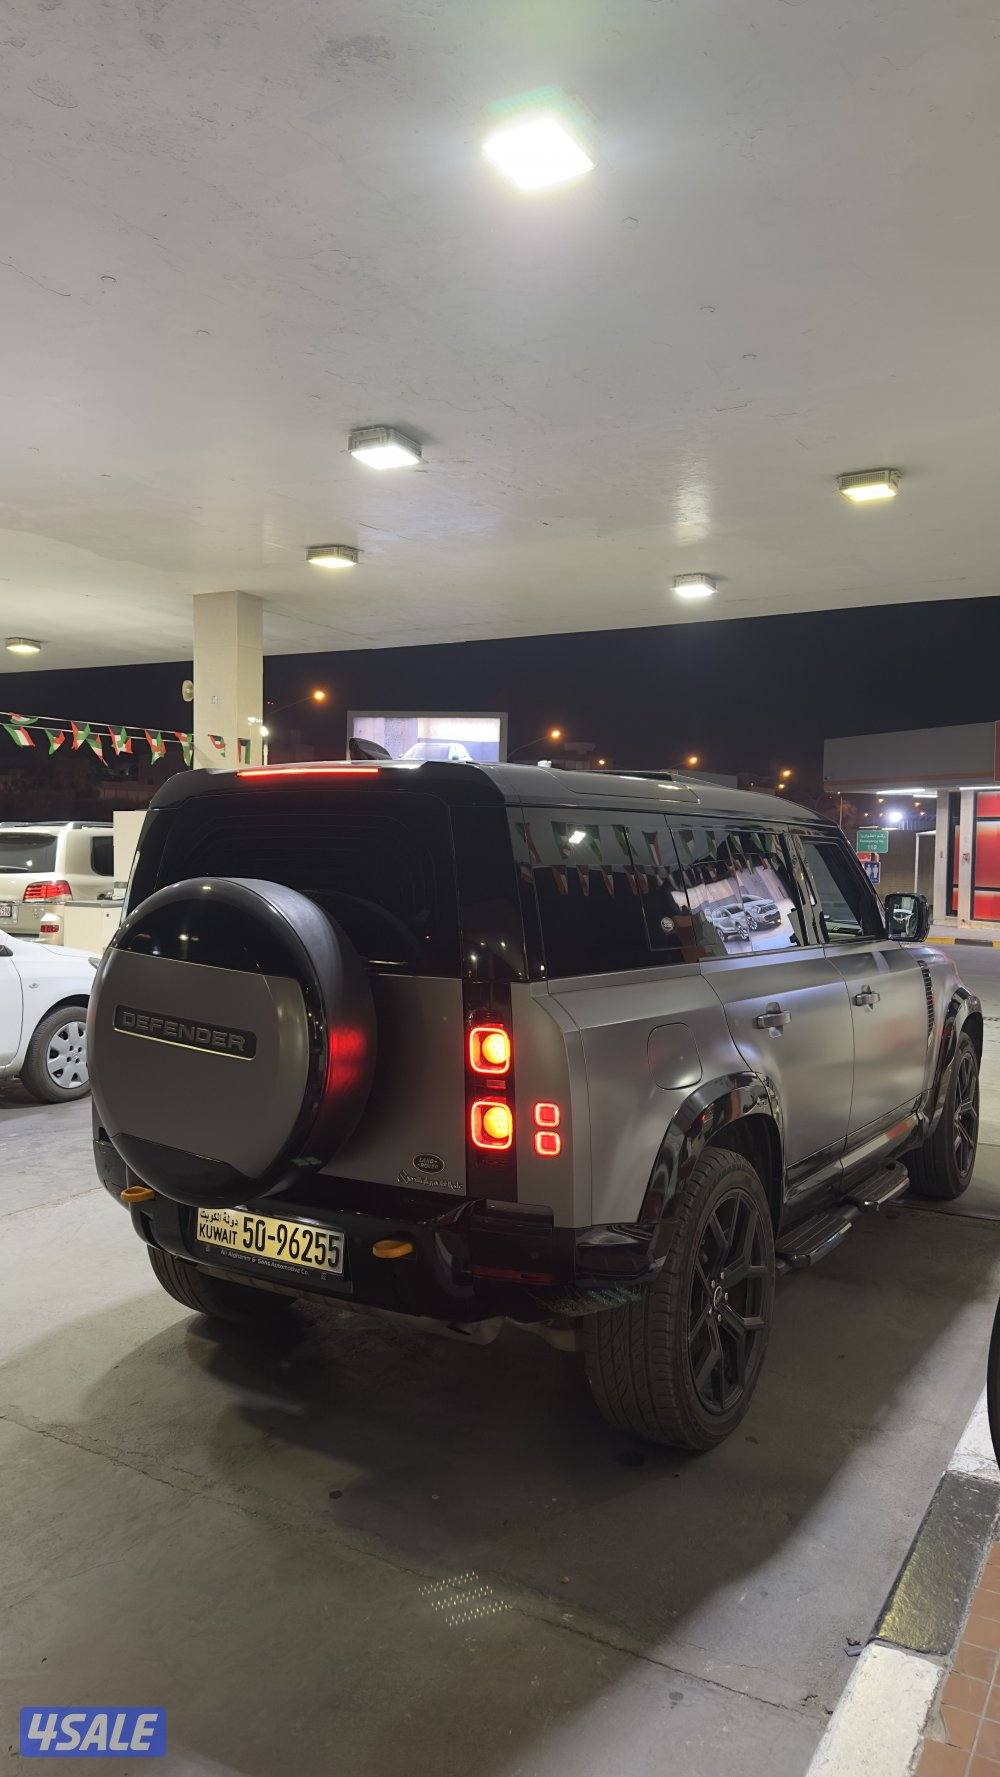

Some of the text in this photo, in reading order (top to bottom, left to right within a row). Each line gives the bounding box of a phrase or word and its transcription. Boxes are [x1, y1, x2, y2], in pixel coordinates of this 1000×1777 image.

[122, 1011, 246, 1051] DEFENDER
[200, 1210, 239, 1227] دولة الكويت
[199, 1222, 238, 1245] KUWAIT
[242, 1216, 340, 1268] 50-96255
[257, 1258, 271, 1267] Sons
[271, 1261, 300, 1274] Automotive
